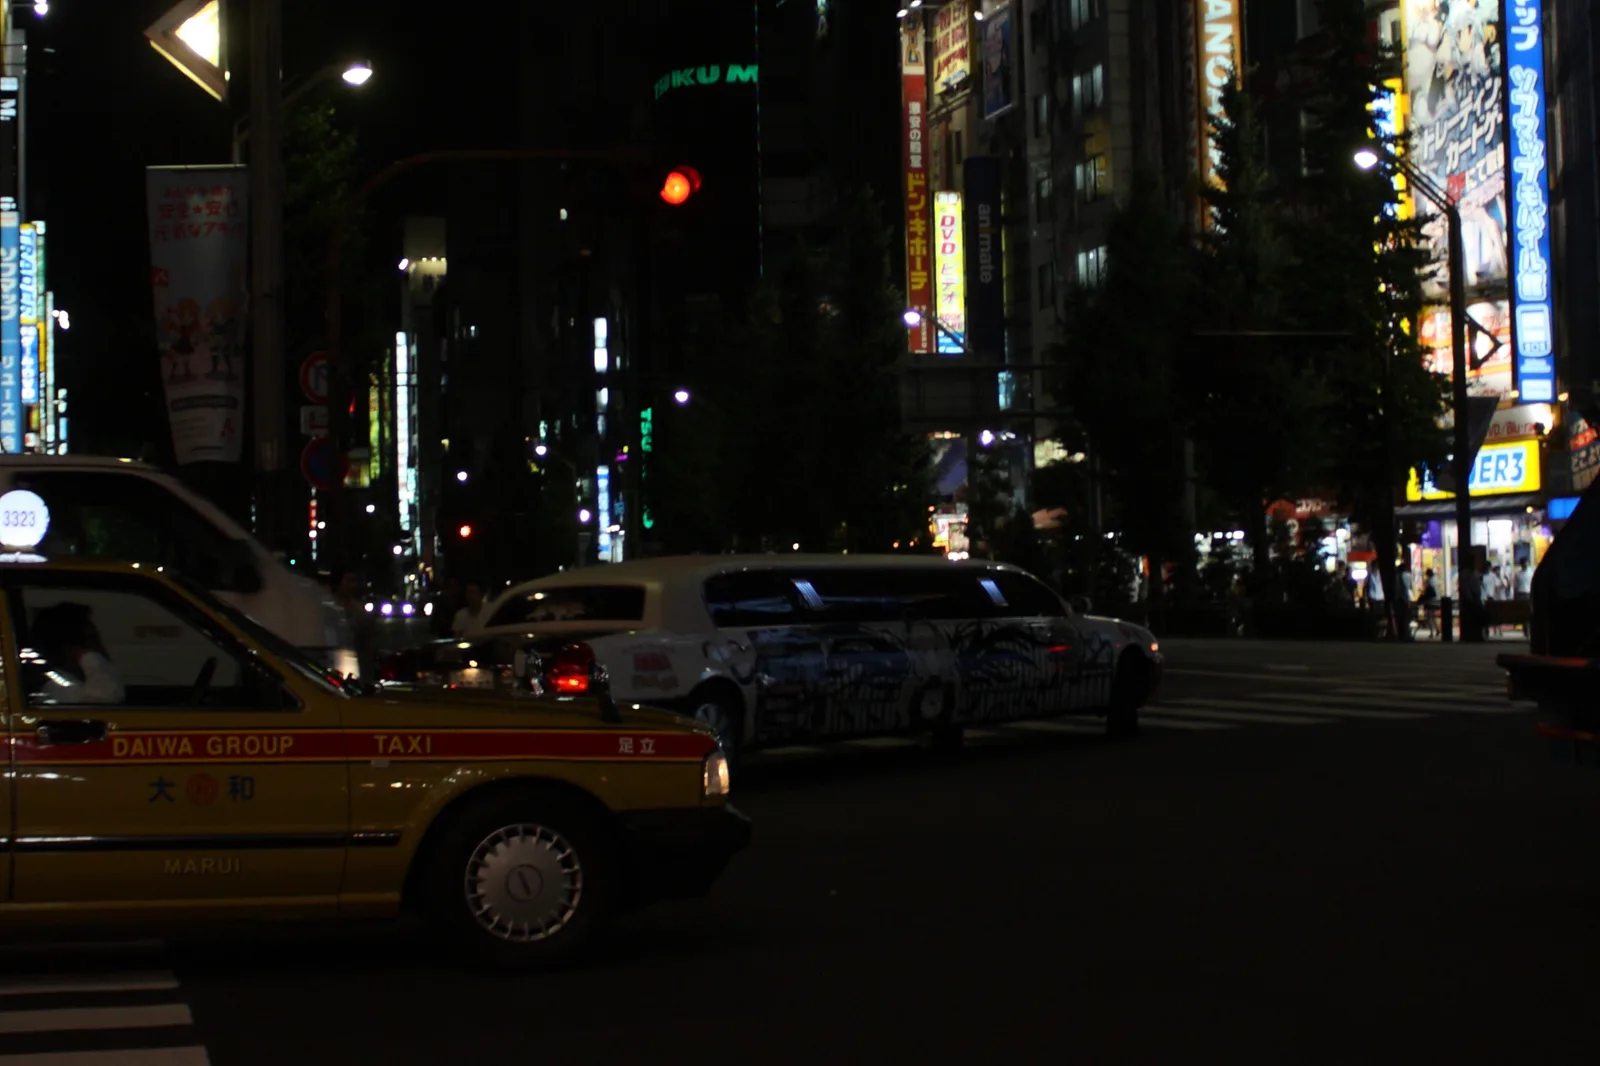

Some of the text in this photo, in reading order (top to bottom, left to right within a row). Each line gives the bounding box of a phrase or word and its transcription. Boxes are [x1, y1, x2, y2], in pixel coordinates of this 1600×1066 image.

[978, 203, 998, 284] animate
[3, 510, 36, 527] 3323
[113, 734, 432, 757] DAIWA GROUP TAXI
[618, 736, 656, 754] 足立
[164, 856, 240, 875] MARUI
